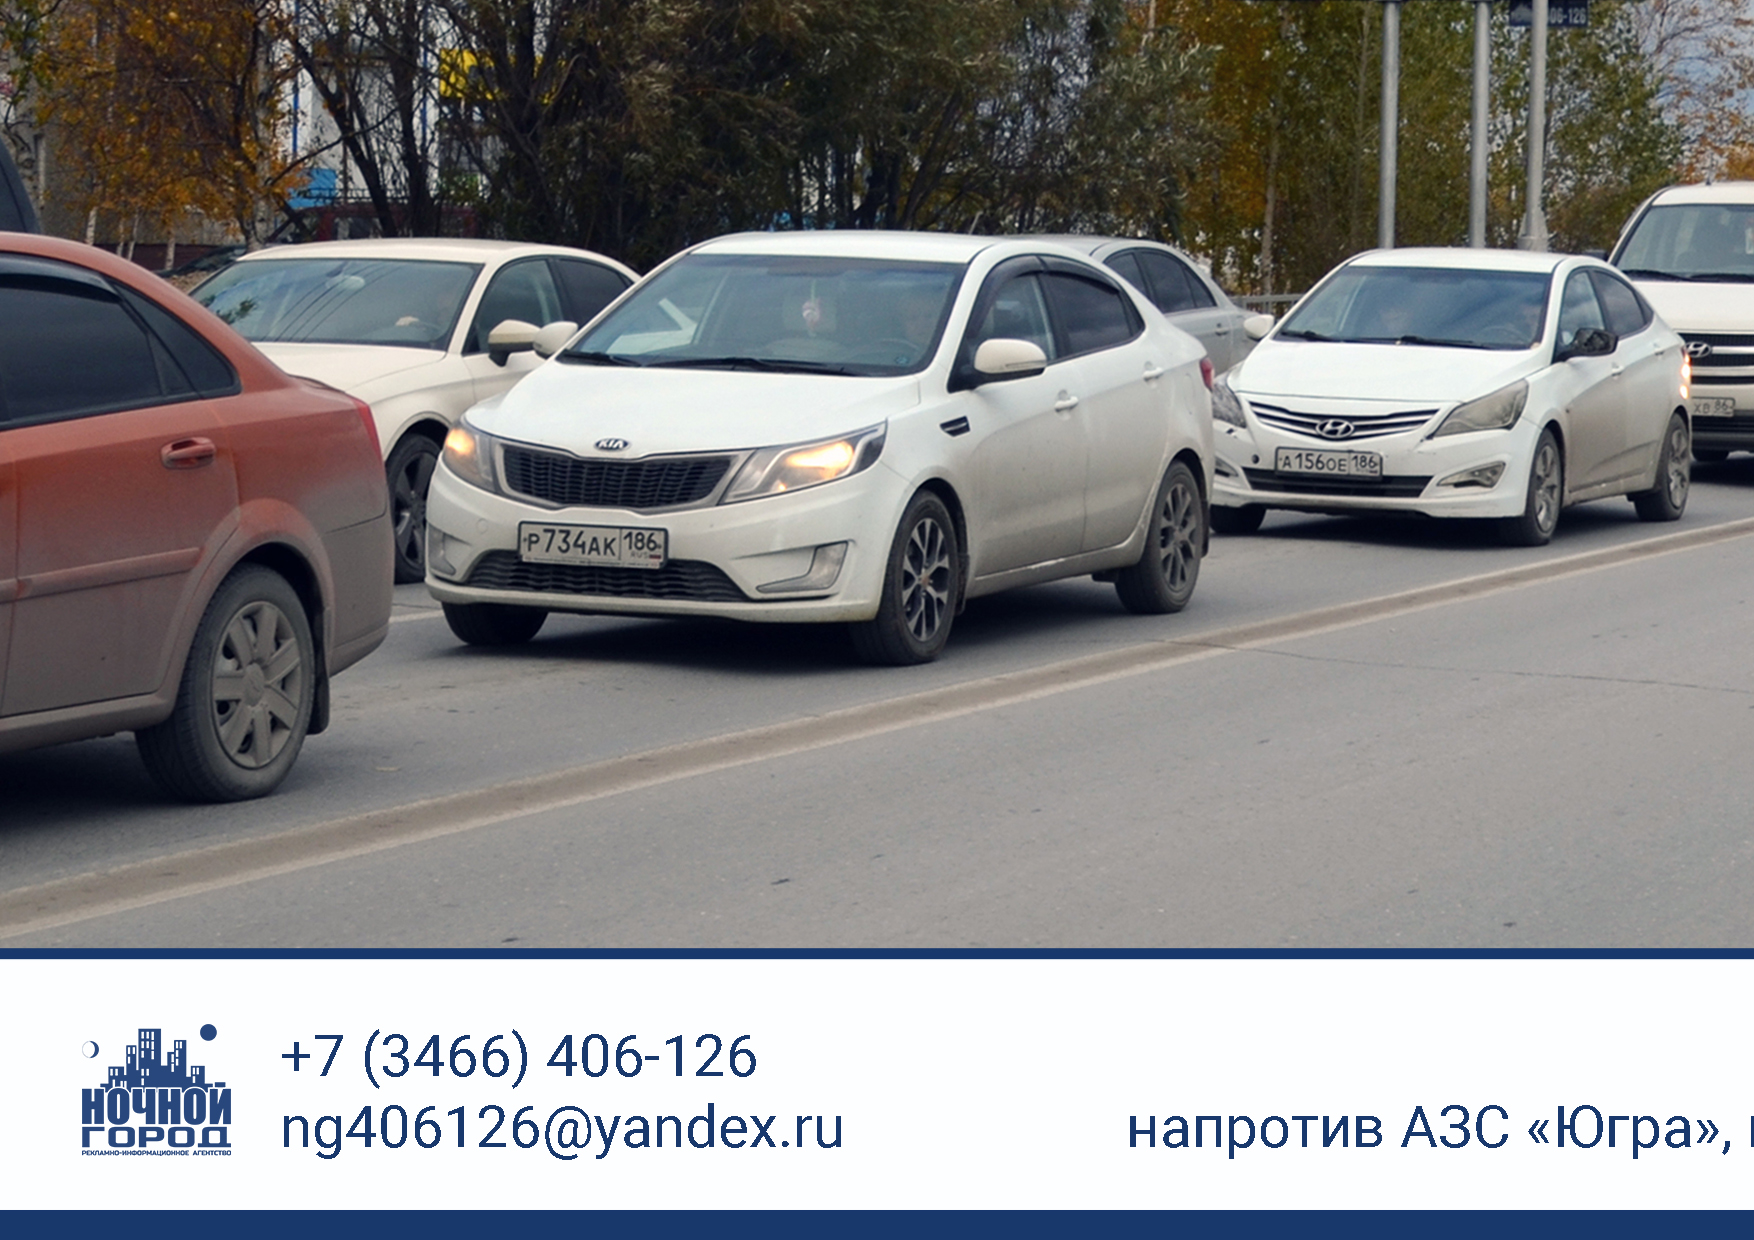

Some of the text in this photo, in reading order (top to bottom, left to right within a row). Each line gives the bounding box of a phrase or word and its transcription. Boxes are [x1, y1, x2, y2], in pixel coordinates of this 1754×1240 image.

[1548, 7, 1587, 25] 06-126
[598, 440, 625, 449] KIA
[1352, 455, 1377, 468] 186
[623, 531, 658, 551] 186
